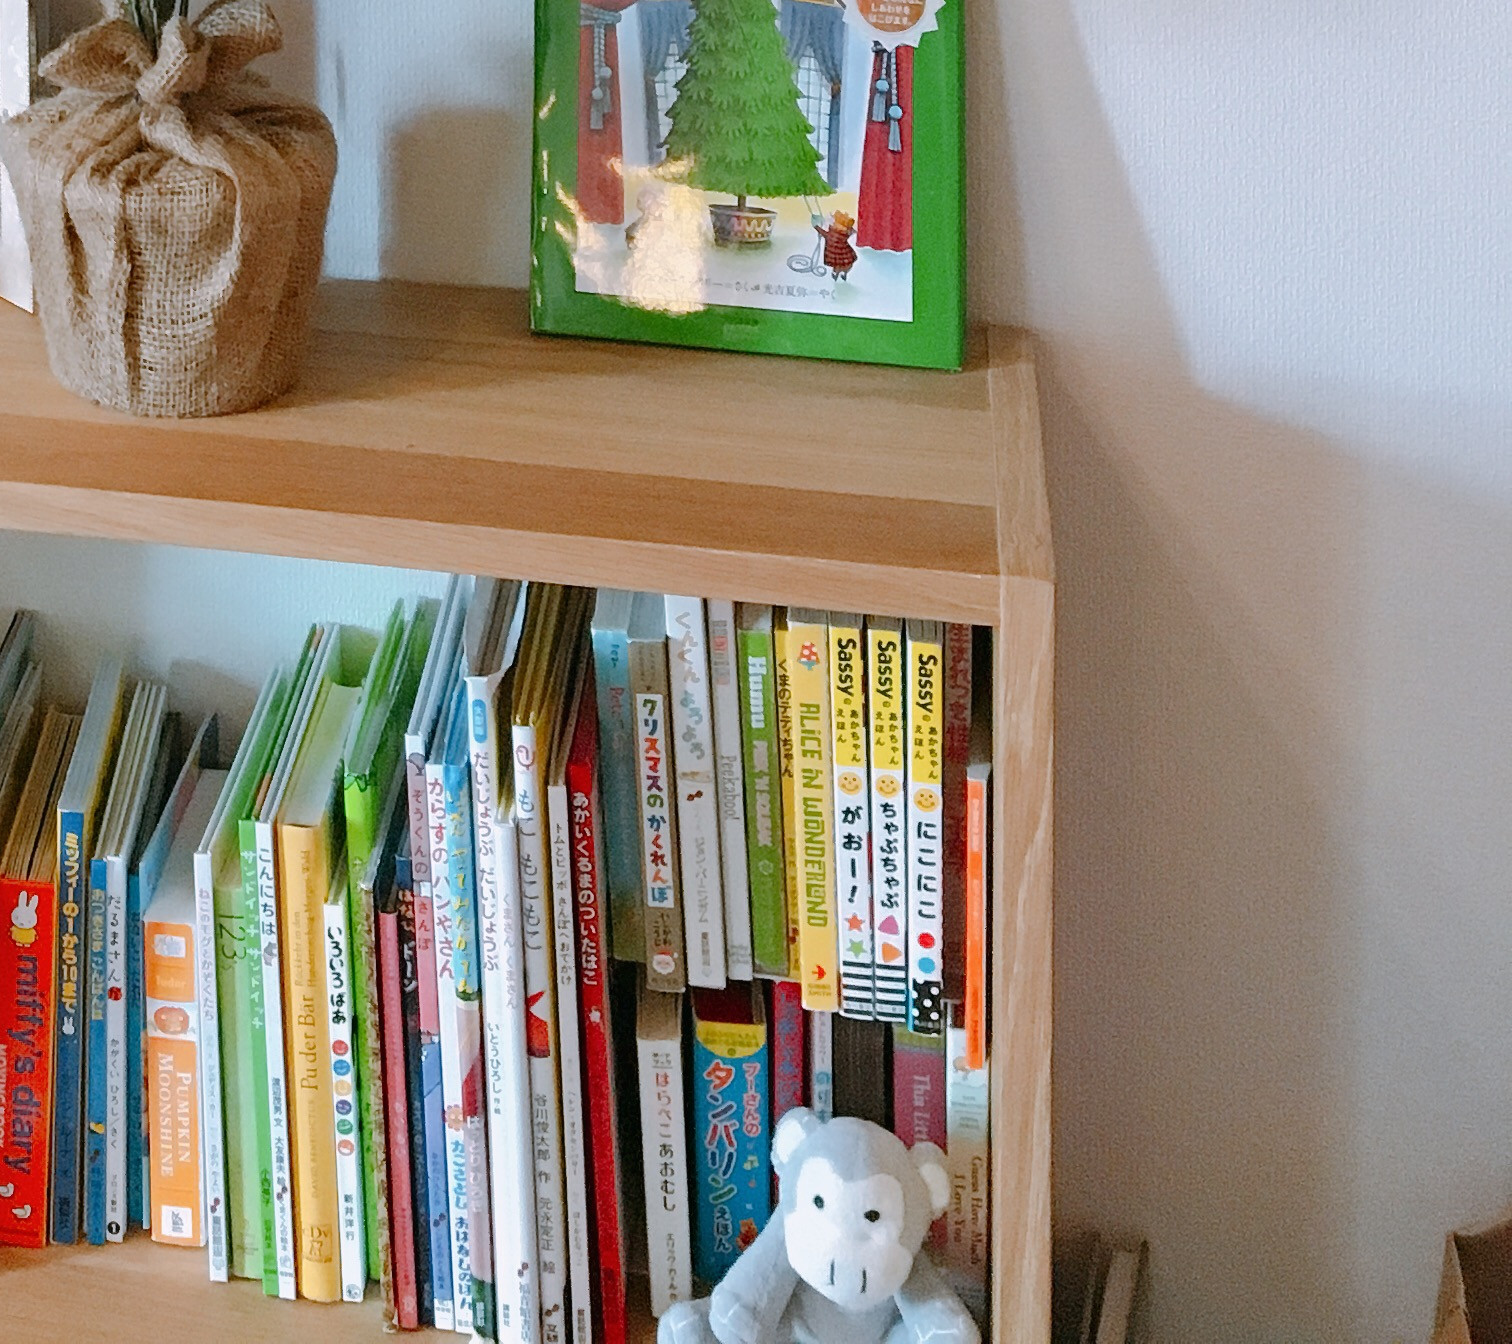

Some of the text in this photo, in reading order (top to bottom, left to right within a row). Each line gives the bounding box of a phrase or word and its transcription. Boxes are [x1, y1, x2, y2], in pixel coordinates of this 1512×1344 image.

[836, 637, 857, 698] Sassy
[876, 640, 897, 700] Sassy
[915, 653, 938, 714] Sassy
[258, 848, 277, 936] こんにちは
[473, 750, 500, 973] だいじょうぶ だいじょうぶ
[517, 792, 543, 953] もこ もこもこ
[572, 791, 598, 987] あかいくるまのついたはこ
[916, 821, 938, 920] にこにこ
[107, 894, 122, 983] だるまさん
[326, 925, 347, 1025] いろいろばあ
[245, 947, 264, 1030] サンドイッチ
[2, 954, 45, 1175] miffy's diary
[297, 993, 319, 1092] Pu der Bär
[487, 1021, 503, 1095] いとうひろし
[157, 1052, 175, 1178] MOONSHINE
[176, 1071, 192, 1163] PUMPKIN
[655, 1072, 677, 1212] はらぺこあおむし
[703, 1060, 739, 1205] タンバリン
[742, 1062, 762, 1138] プーさんの
[714, 1205, 733, 1254] えほん
